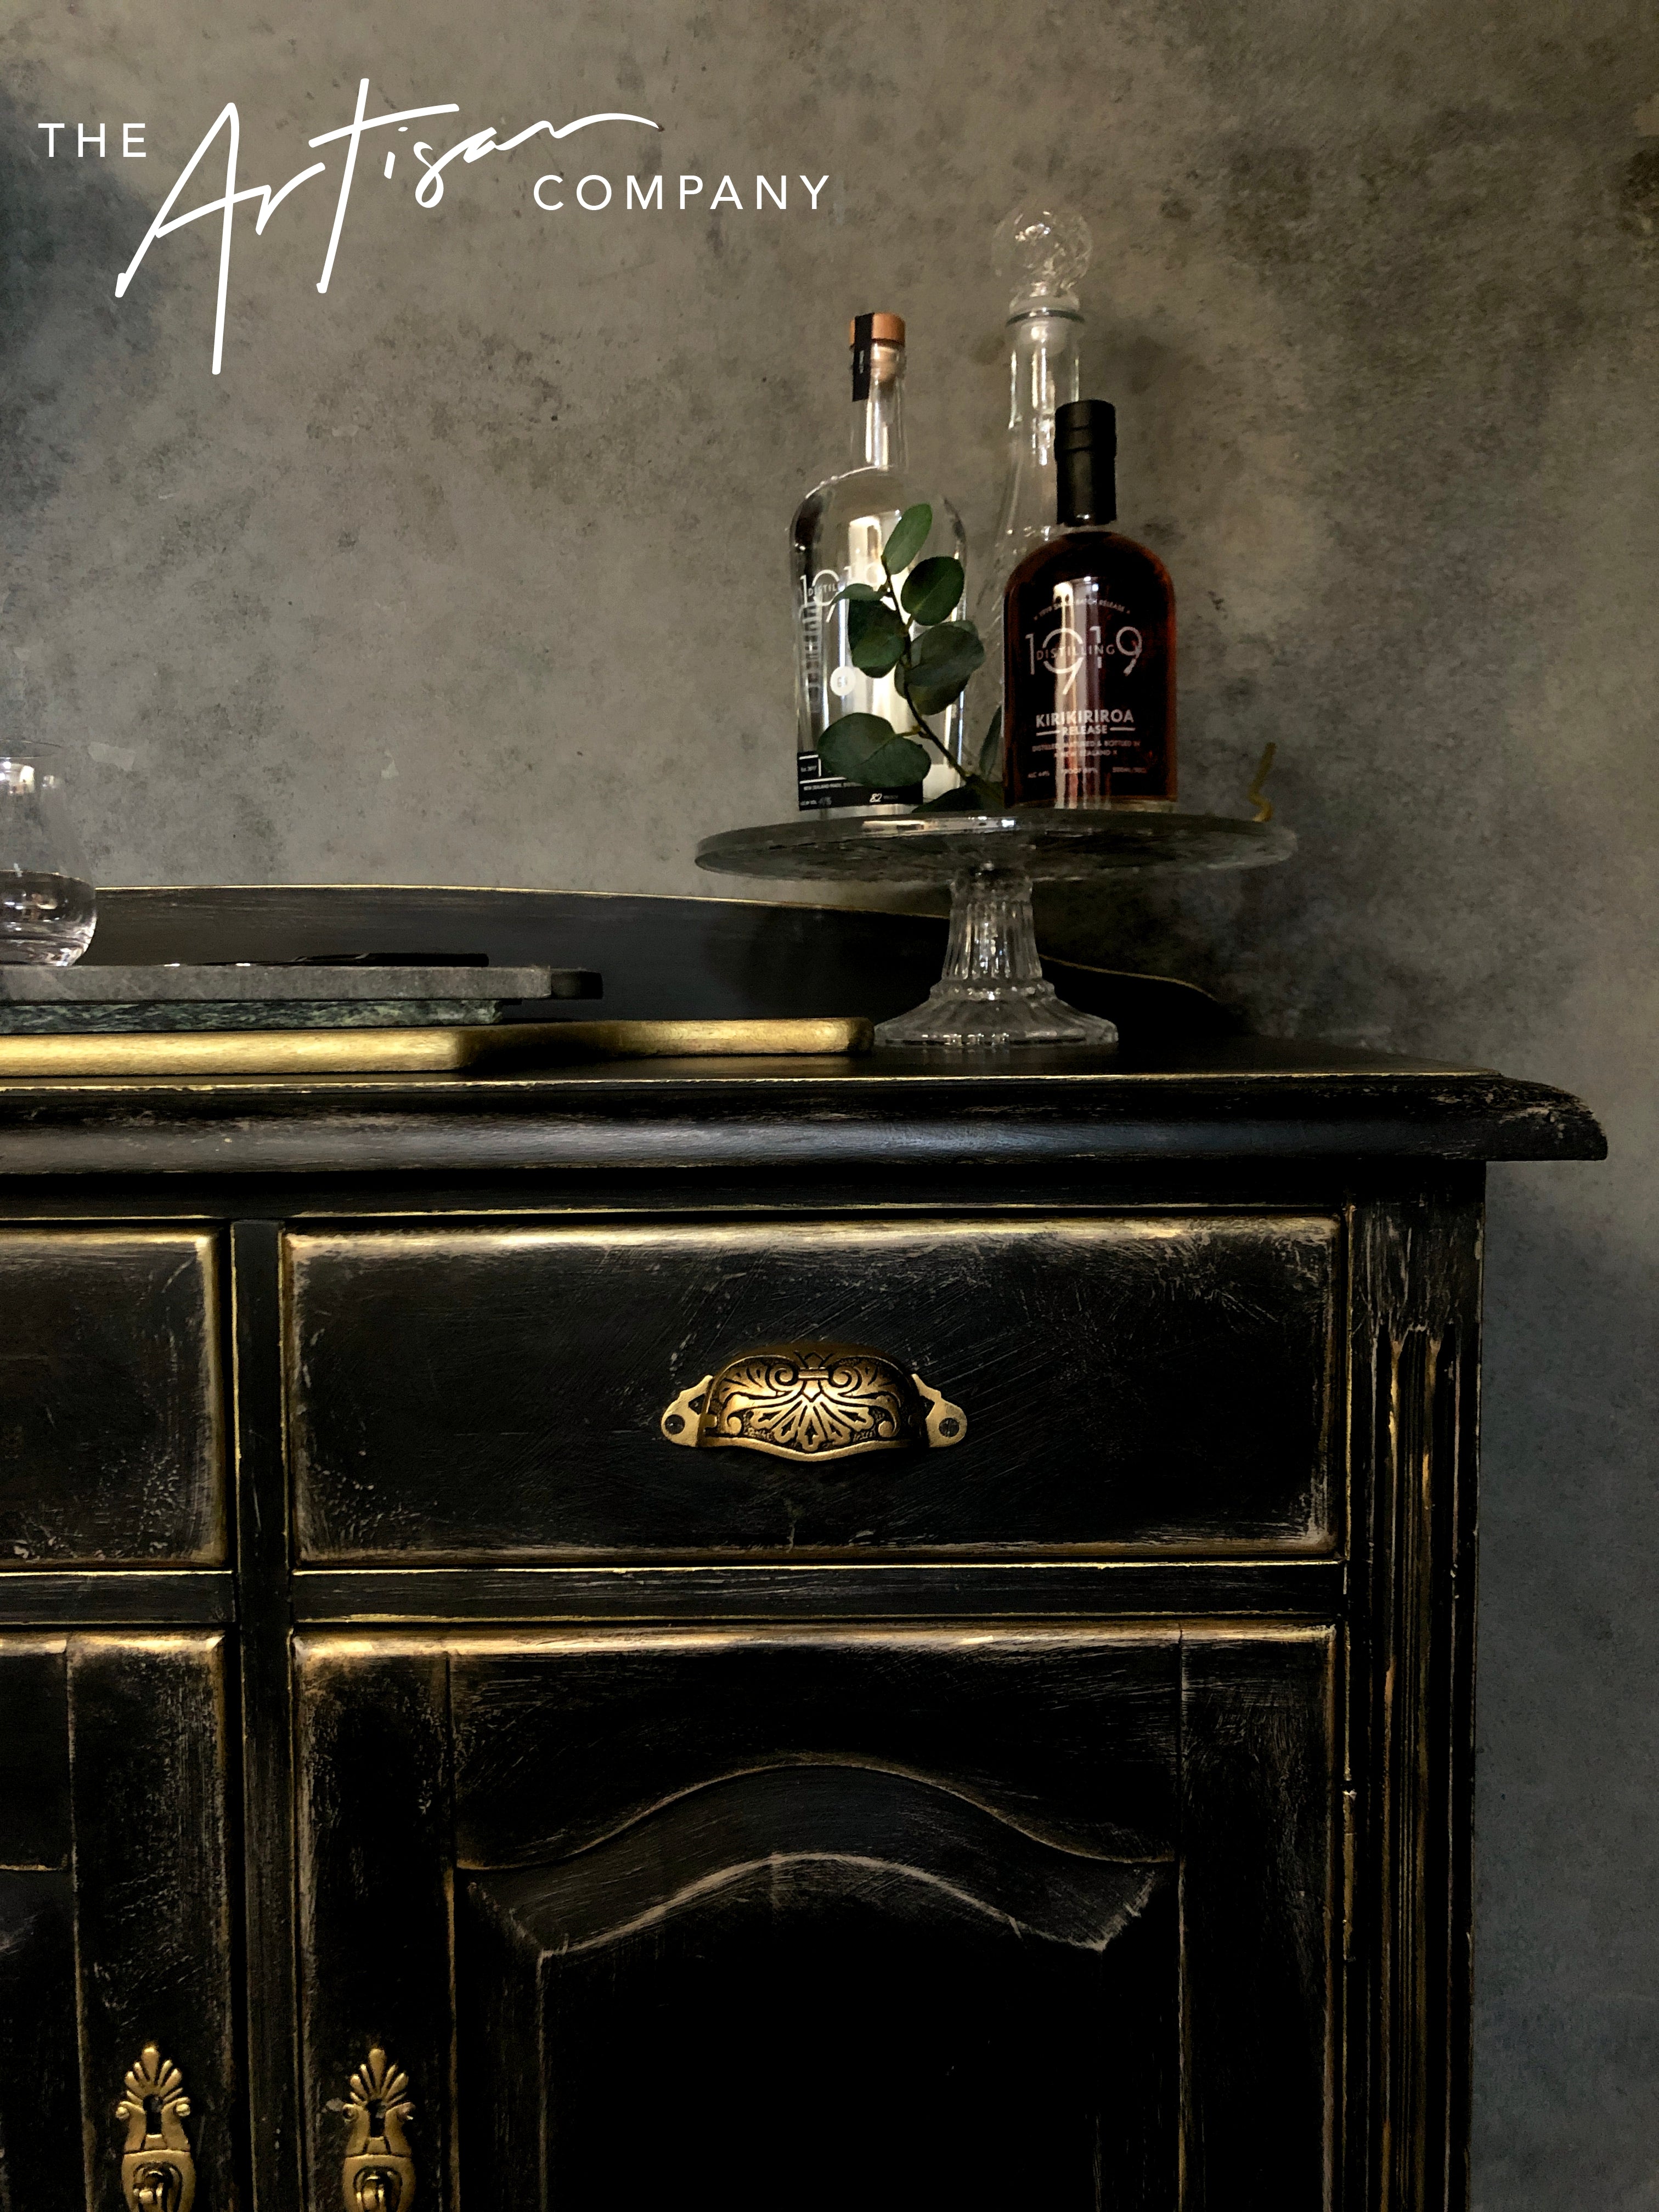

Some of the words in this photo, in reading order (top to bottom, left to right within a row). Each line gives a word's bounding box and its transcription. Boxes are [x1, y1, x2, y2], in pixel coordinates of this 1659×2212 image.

[1025, 625, 1142, 695] 1919
[1036, 645, 1115, 661] DISTILLING
[1036, 709, 1135, 728] KIRIKIRIROA
[1062, 724, 1108, 736] RELEASE
